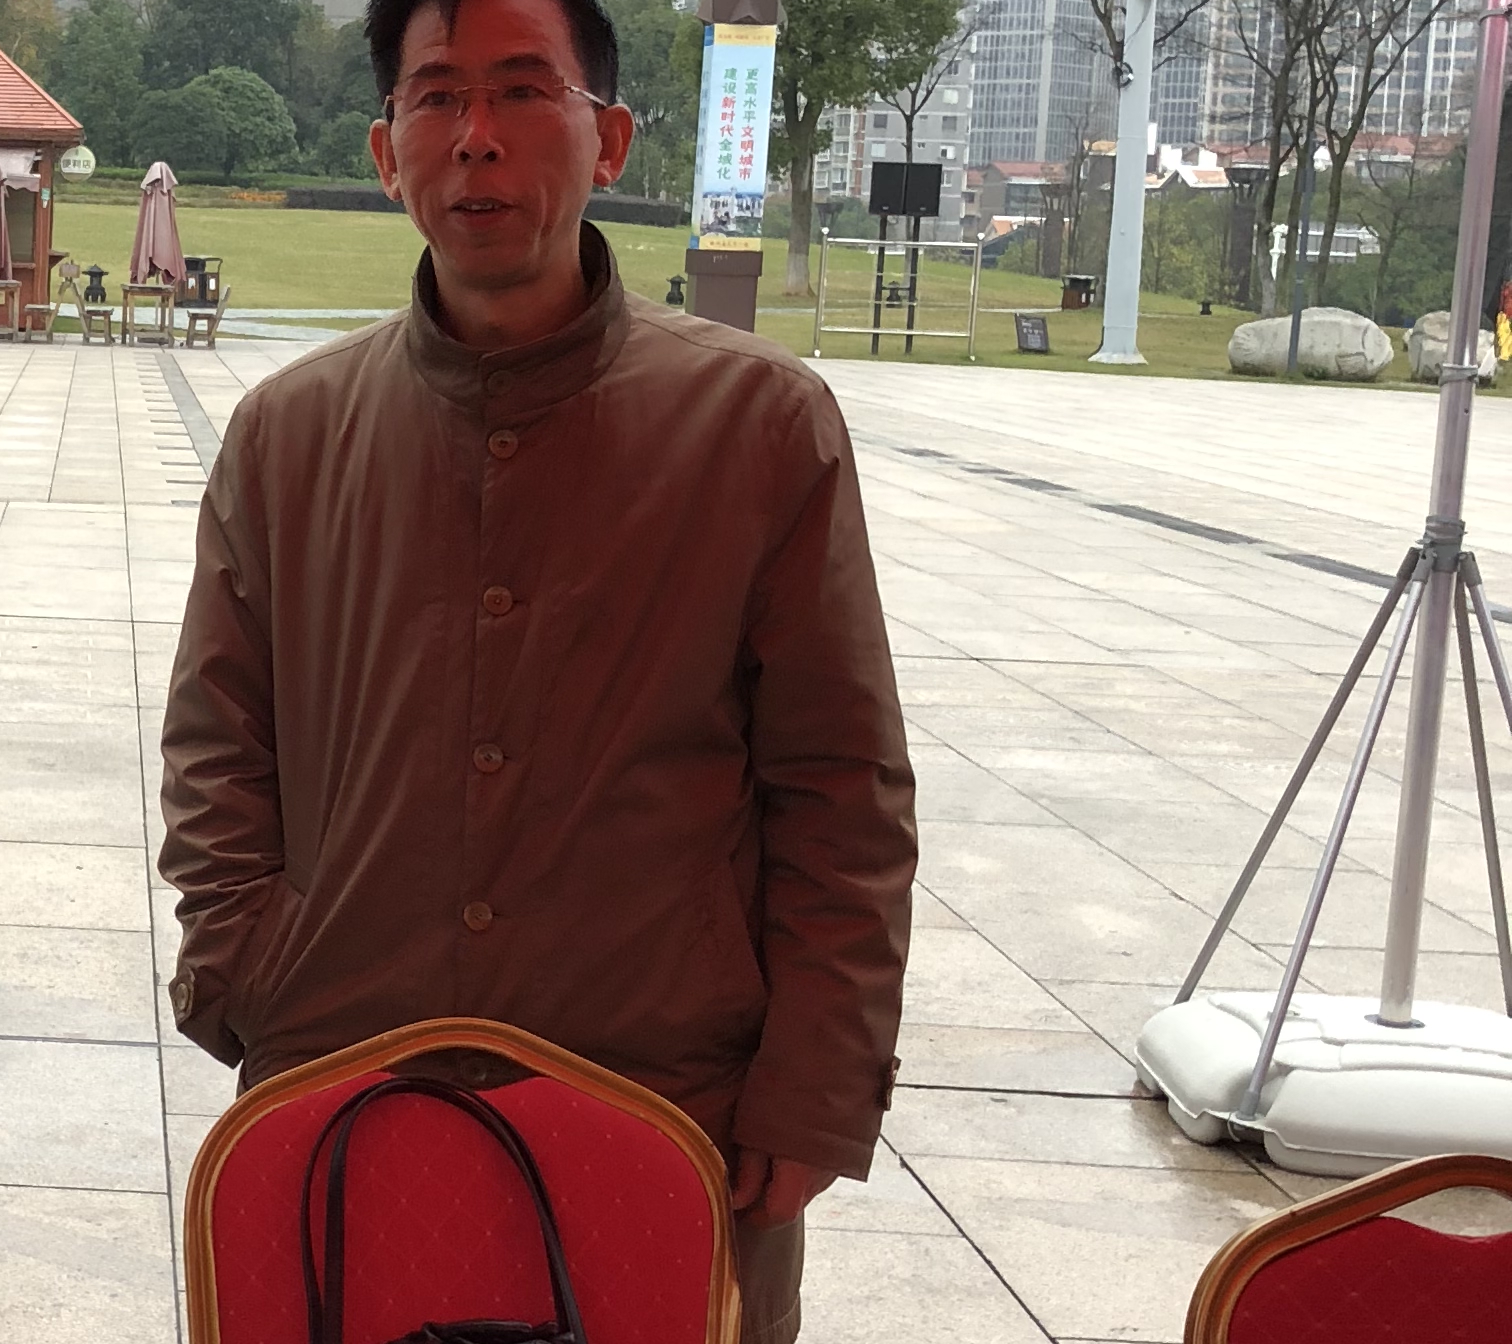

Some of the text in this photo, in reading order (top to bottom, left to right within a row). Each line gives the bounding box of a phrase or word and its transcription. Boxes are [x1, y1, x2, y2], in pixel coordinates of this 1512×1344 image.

[62, 158, 92, 170] 便利店
[716, 67, 738, 180] 建设新时代全域化
[738, 67, 759, 181] 更高水平文明城市
